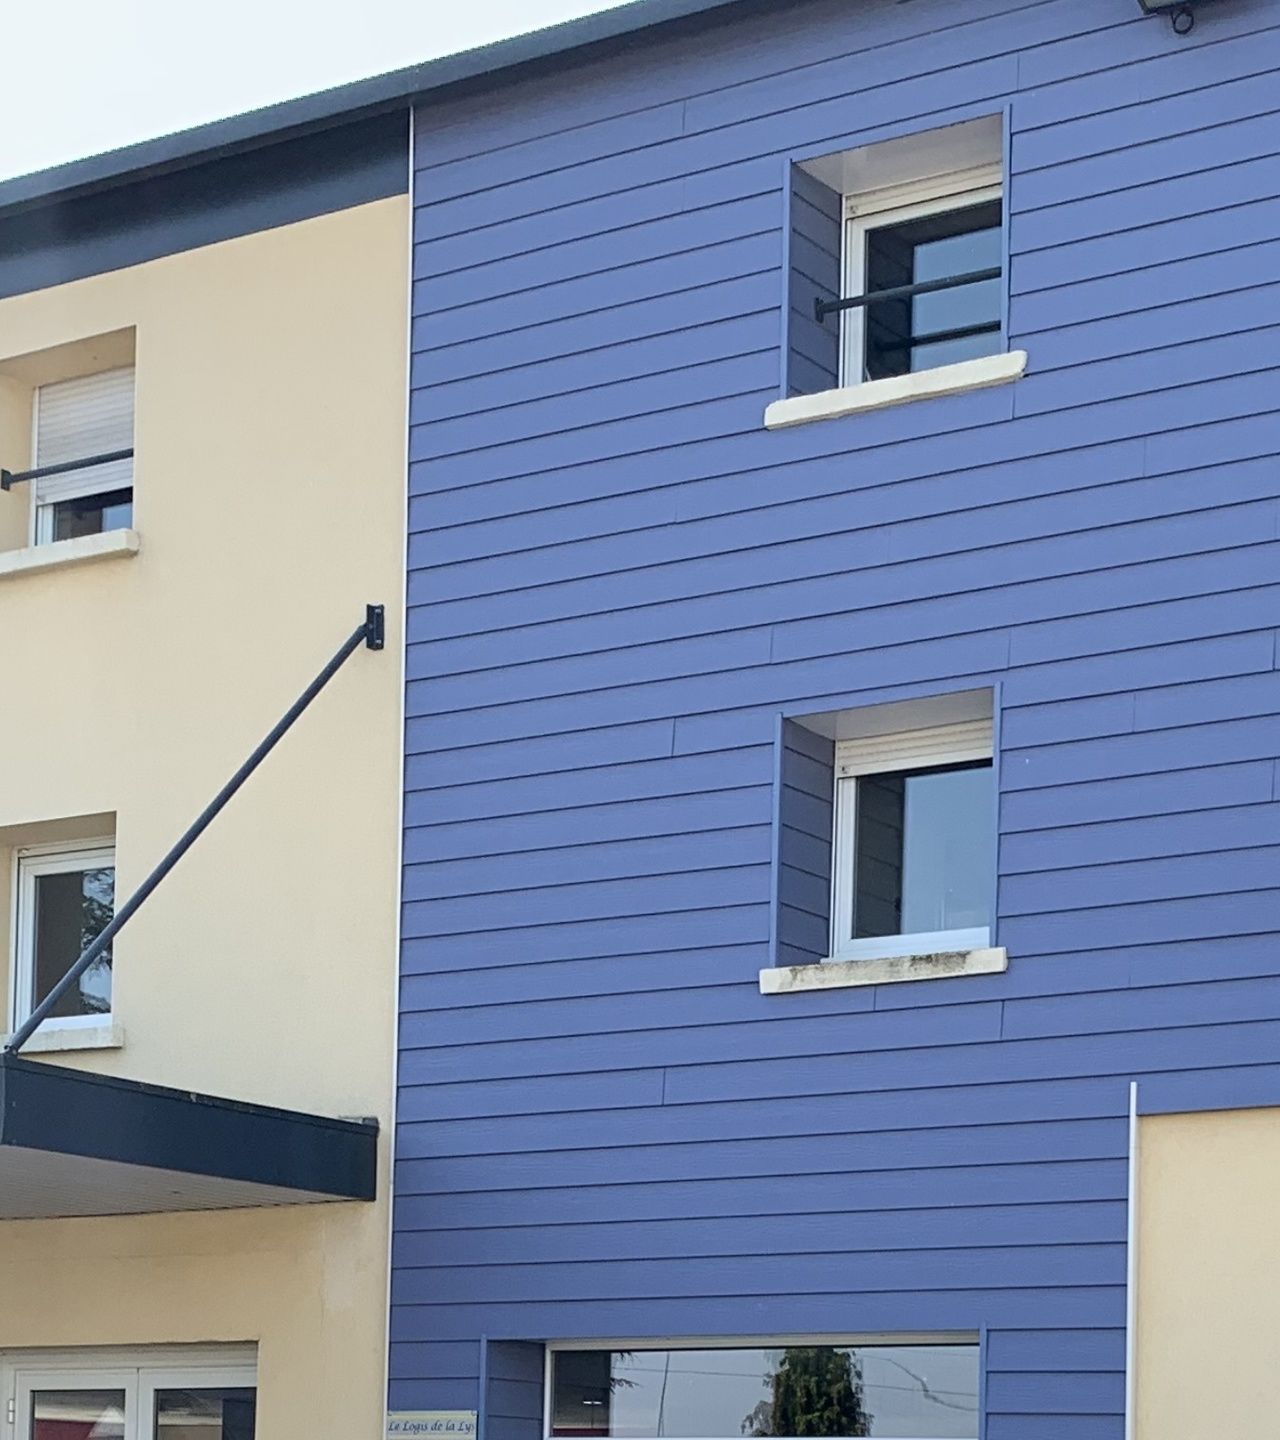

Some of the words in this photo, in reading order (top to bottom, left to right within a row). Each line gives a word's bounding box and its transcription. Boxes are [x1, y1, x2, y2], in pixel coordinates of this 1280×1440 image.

[402, 1421, 428, 1435] Logis
[431, 1420, 443, 1431] de
[446, 1420, 455, 1431] la
